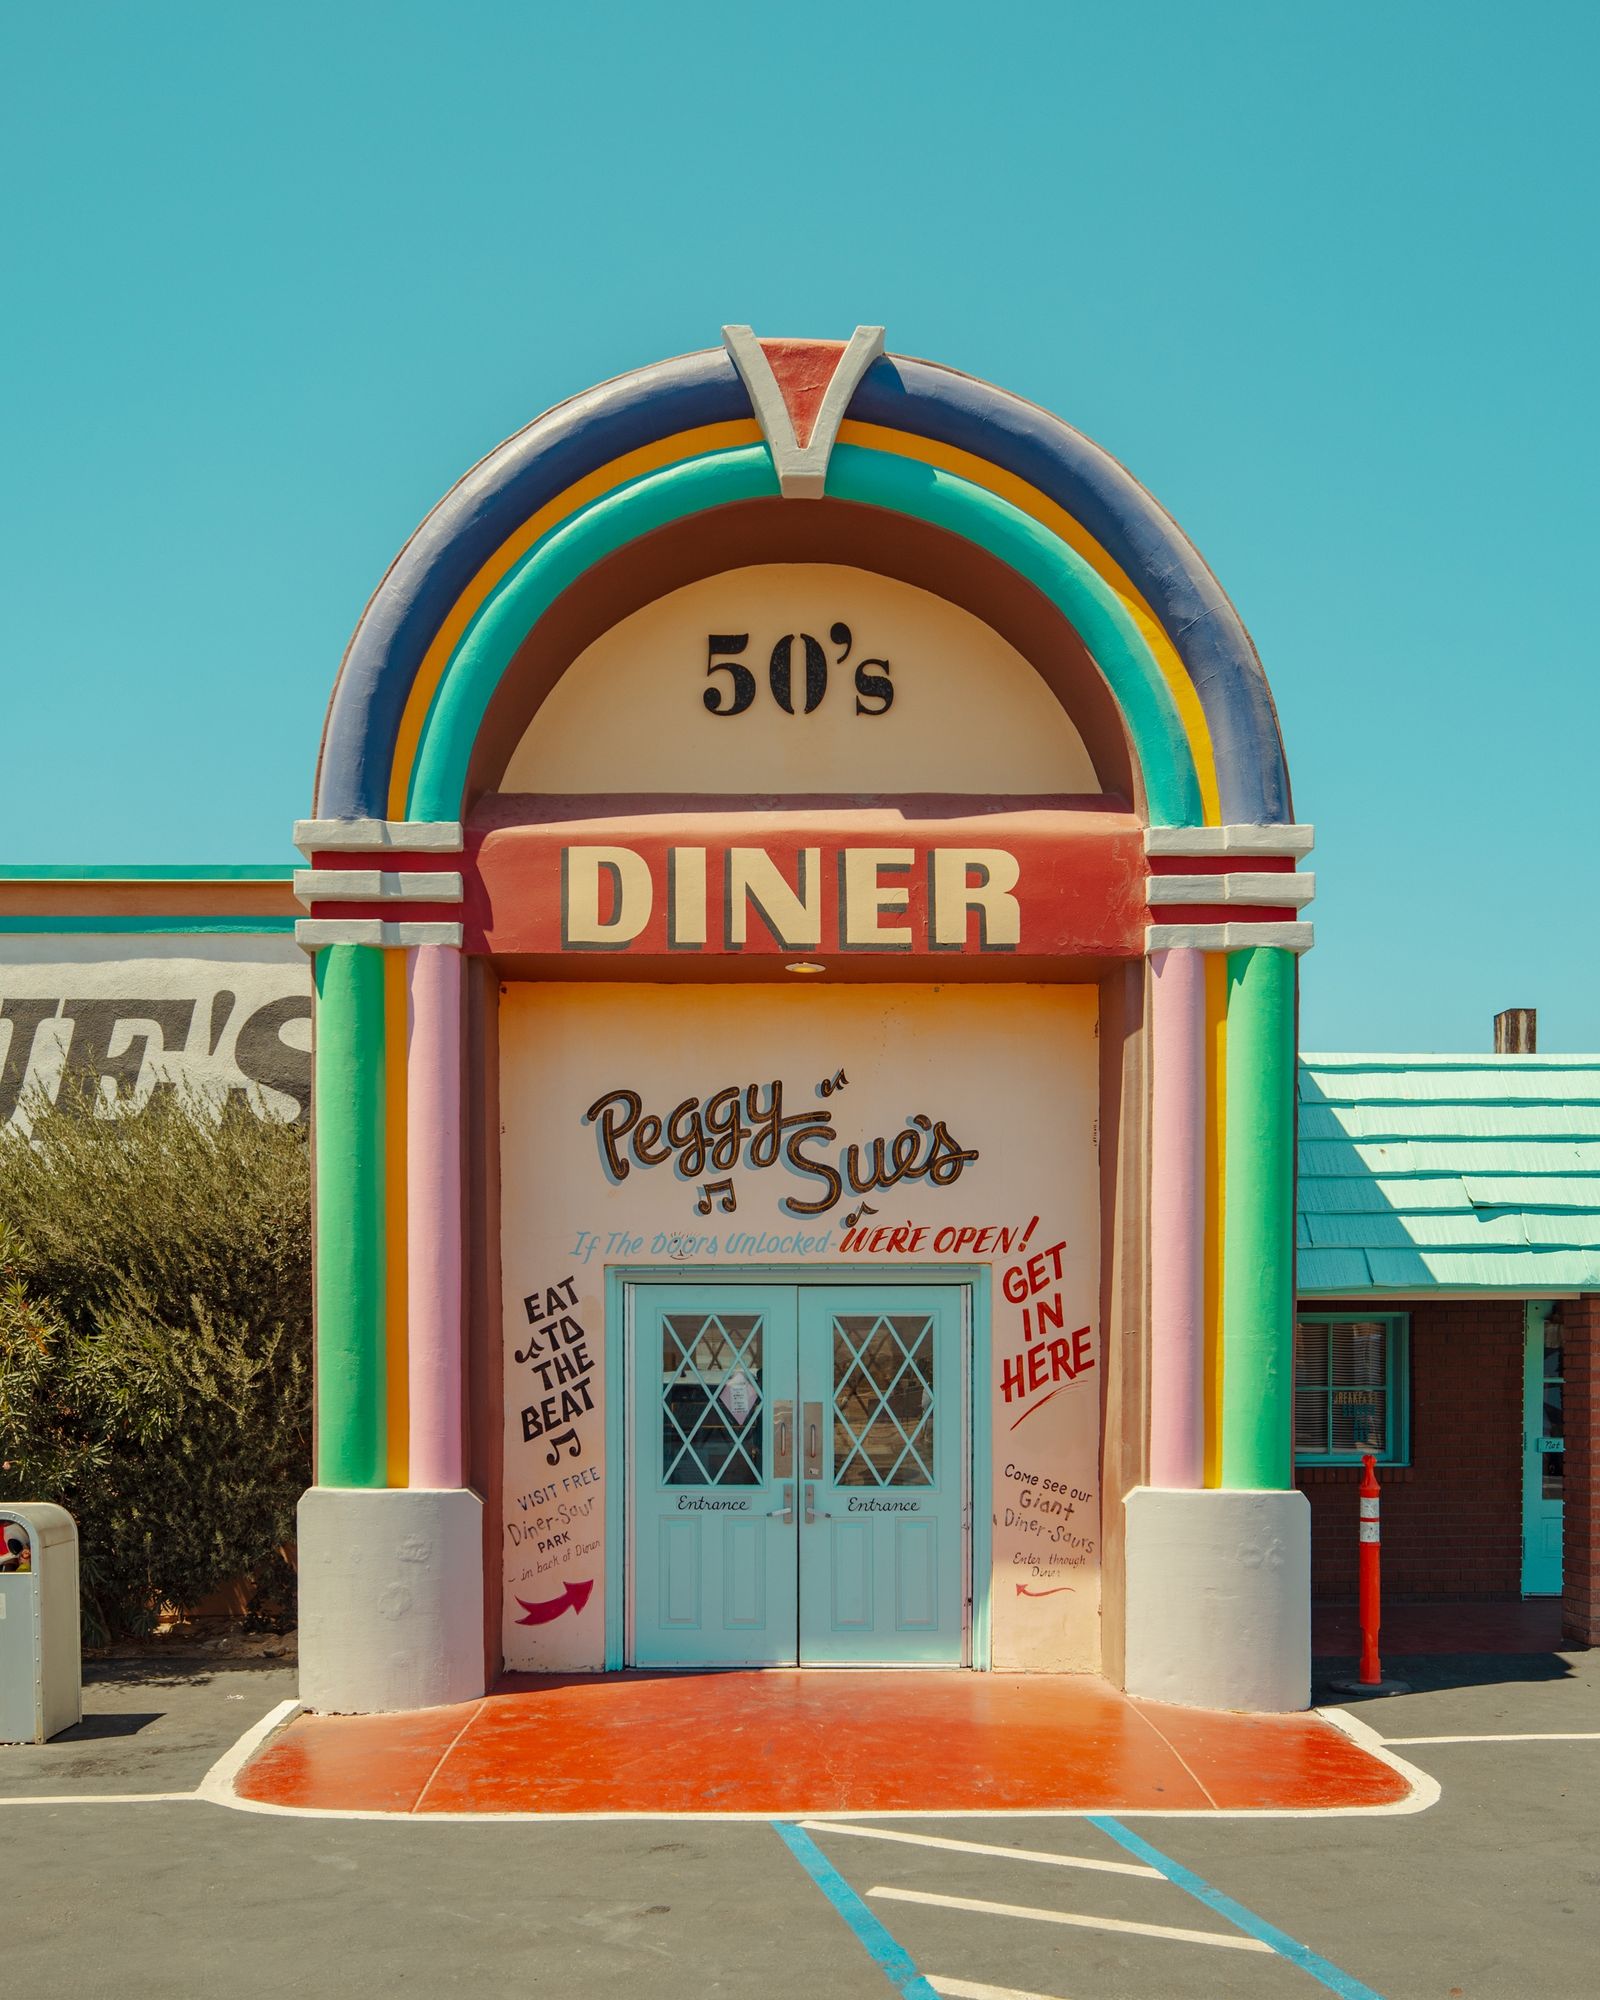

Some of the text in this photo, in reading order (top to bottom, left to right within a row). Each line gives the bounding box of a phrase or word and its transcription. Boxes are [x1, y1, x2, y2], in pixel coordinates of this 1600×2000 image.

[703, 622, 894, 716] 50's
[561, 845, 1021, 951] DINER
[582, 1080, 831, 1186] Peggy
[780, 1114, 979, 1219] Sue's
[569, 1231, 601, 1264] If
[605, 1231, 644, 1255] The
[650, 1230, 718, 1257] Doors
[933, 1216, 1040, 1254] OPEN!
[1002, 1241, 1067, 1304] GET
[524, 1275, 579, 1324] EAT
[1023, 1293, 1064, 1342] IN
[539, 1315, 585, 1352] TO
[531, 1342, 595, 1391] THE
[1000, 1325, 1095, 1403] HERE
[521, 1377, 595, 1443] BEAT
[517, 1466, 601, 1511] VISIT FREE
[677, 1494, 750, 1511] Entrance
[847, 1496, 921, 1512] Entrance
[1020, 1489, 1075, 1521] Giant
[1042, 1478, 1068, 1495] see
[1070, 1488, 1093, 1503] our
[537, 1531, 572, 1554] PARK
